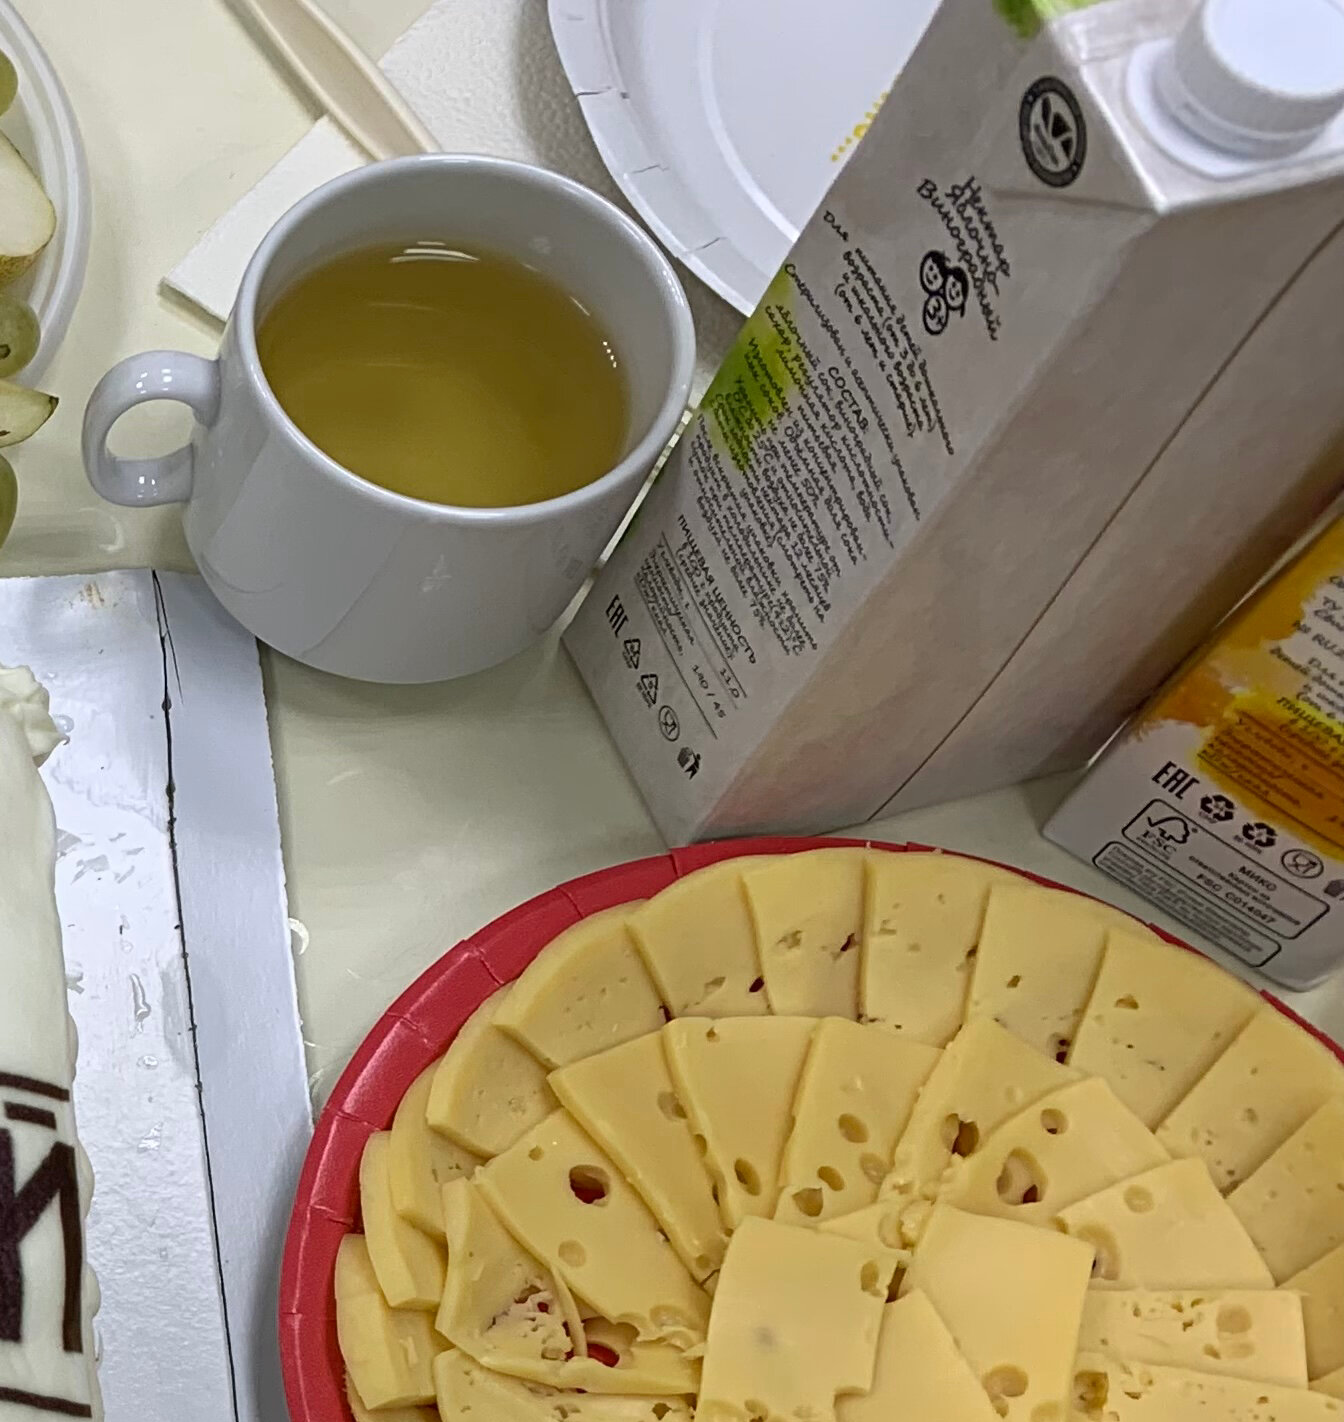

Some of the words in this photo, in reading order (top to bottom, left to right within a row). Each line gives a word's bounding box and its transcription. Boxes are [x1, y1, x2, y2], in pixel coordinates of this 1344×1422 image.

[822, 210, 848, 242] Для
[917, 179, 1002, 340] Виноградный
[963, 176, 1010, 278] Нектар
[926, 300, 946, 327] 3+
[677, 514, 714, 585] ПИЩЕВАЯ
[711, 586, 756, 663] ЦЕННОСТЬ
